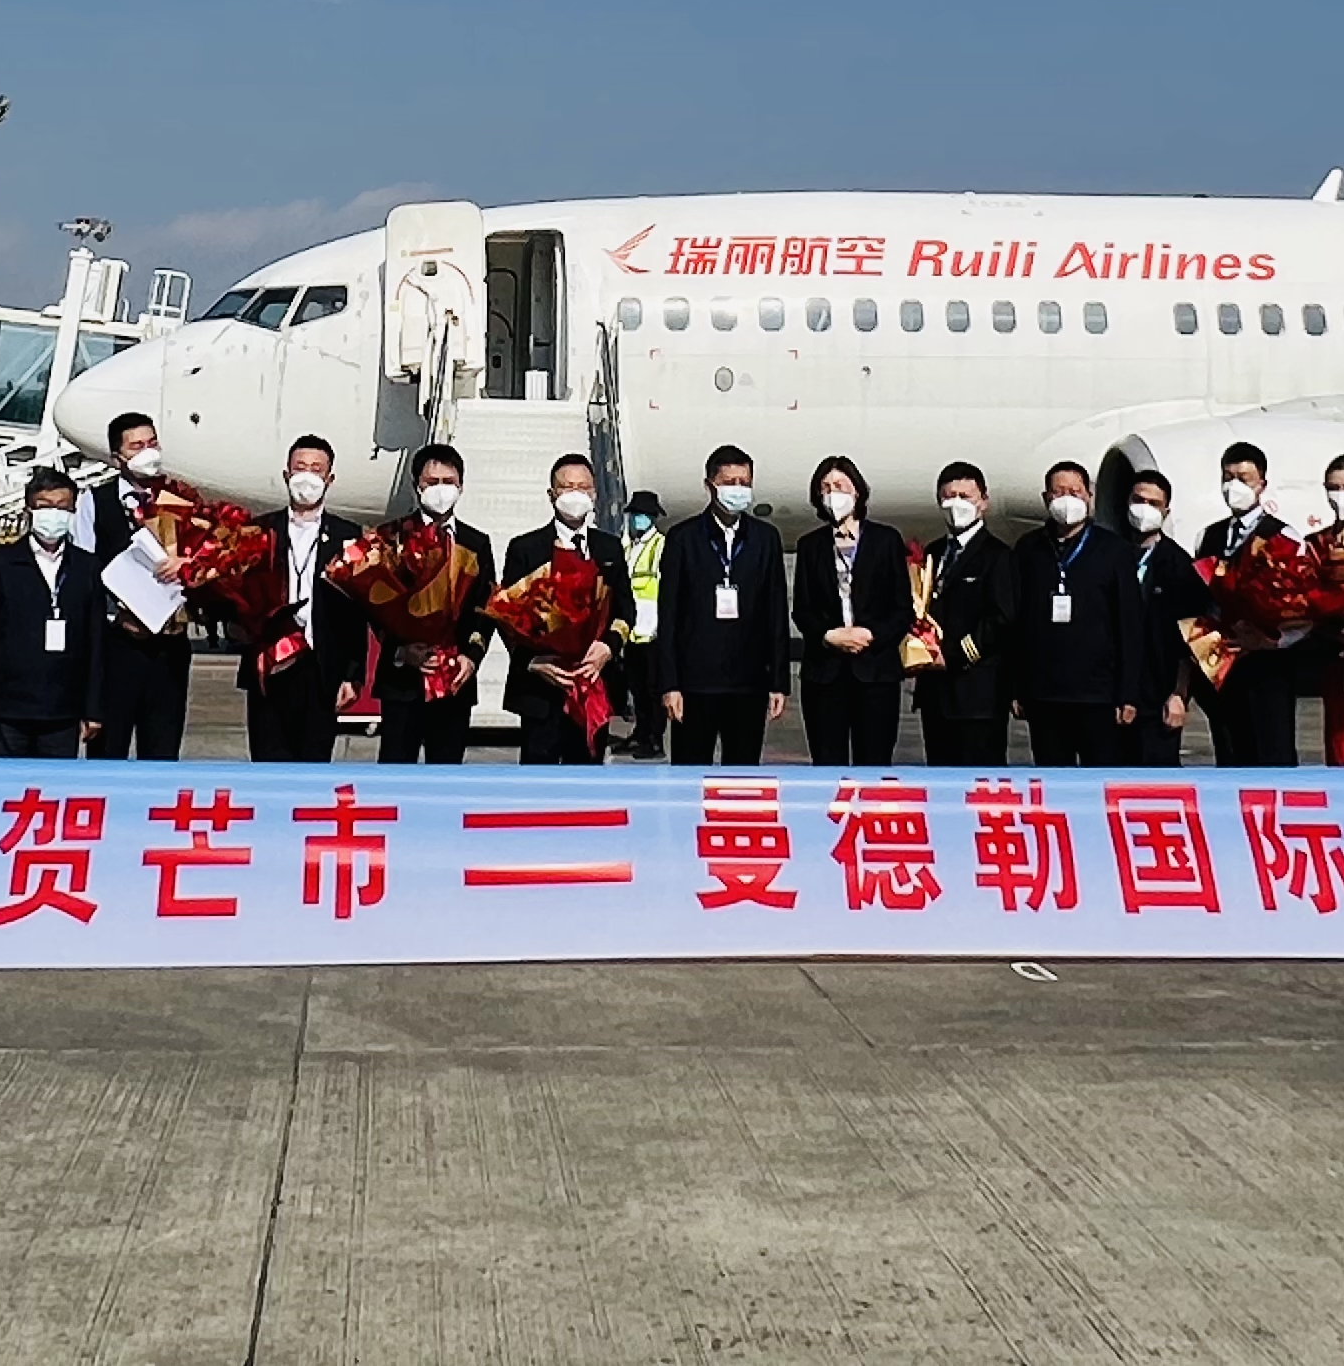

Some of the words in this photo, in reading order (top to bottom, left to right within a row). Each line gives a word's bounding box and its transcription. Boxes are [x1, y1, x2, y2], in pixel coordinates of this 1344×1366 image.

[663, 236, 886, 276] 瑞丽航空
[906, 240, 1036, 277] Ruili
[1053, 241, 1277, 281] Airlines
